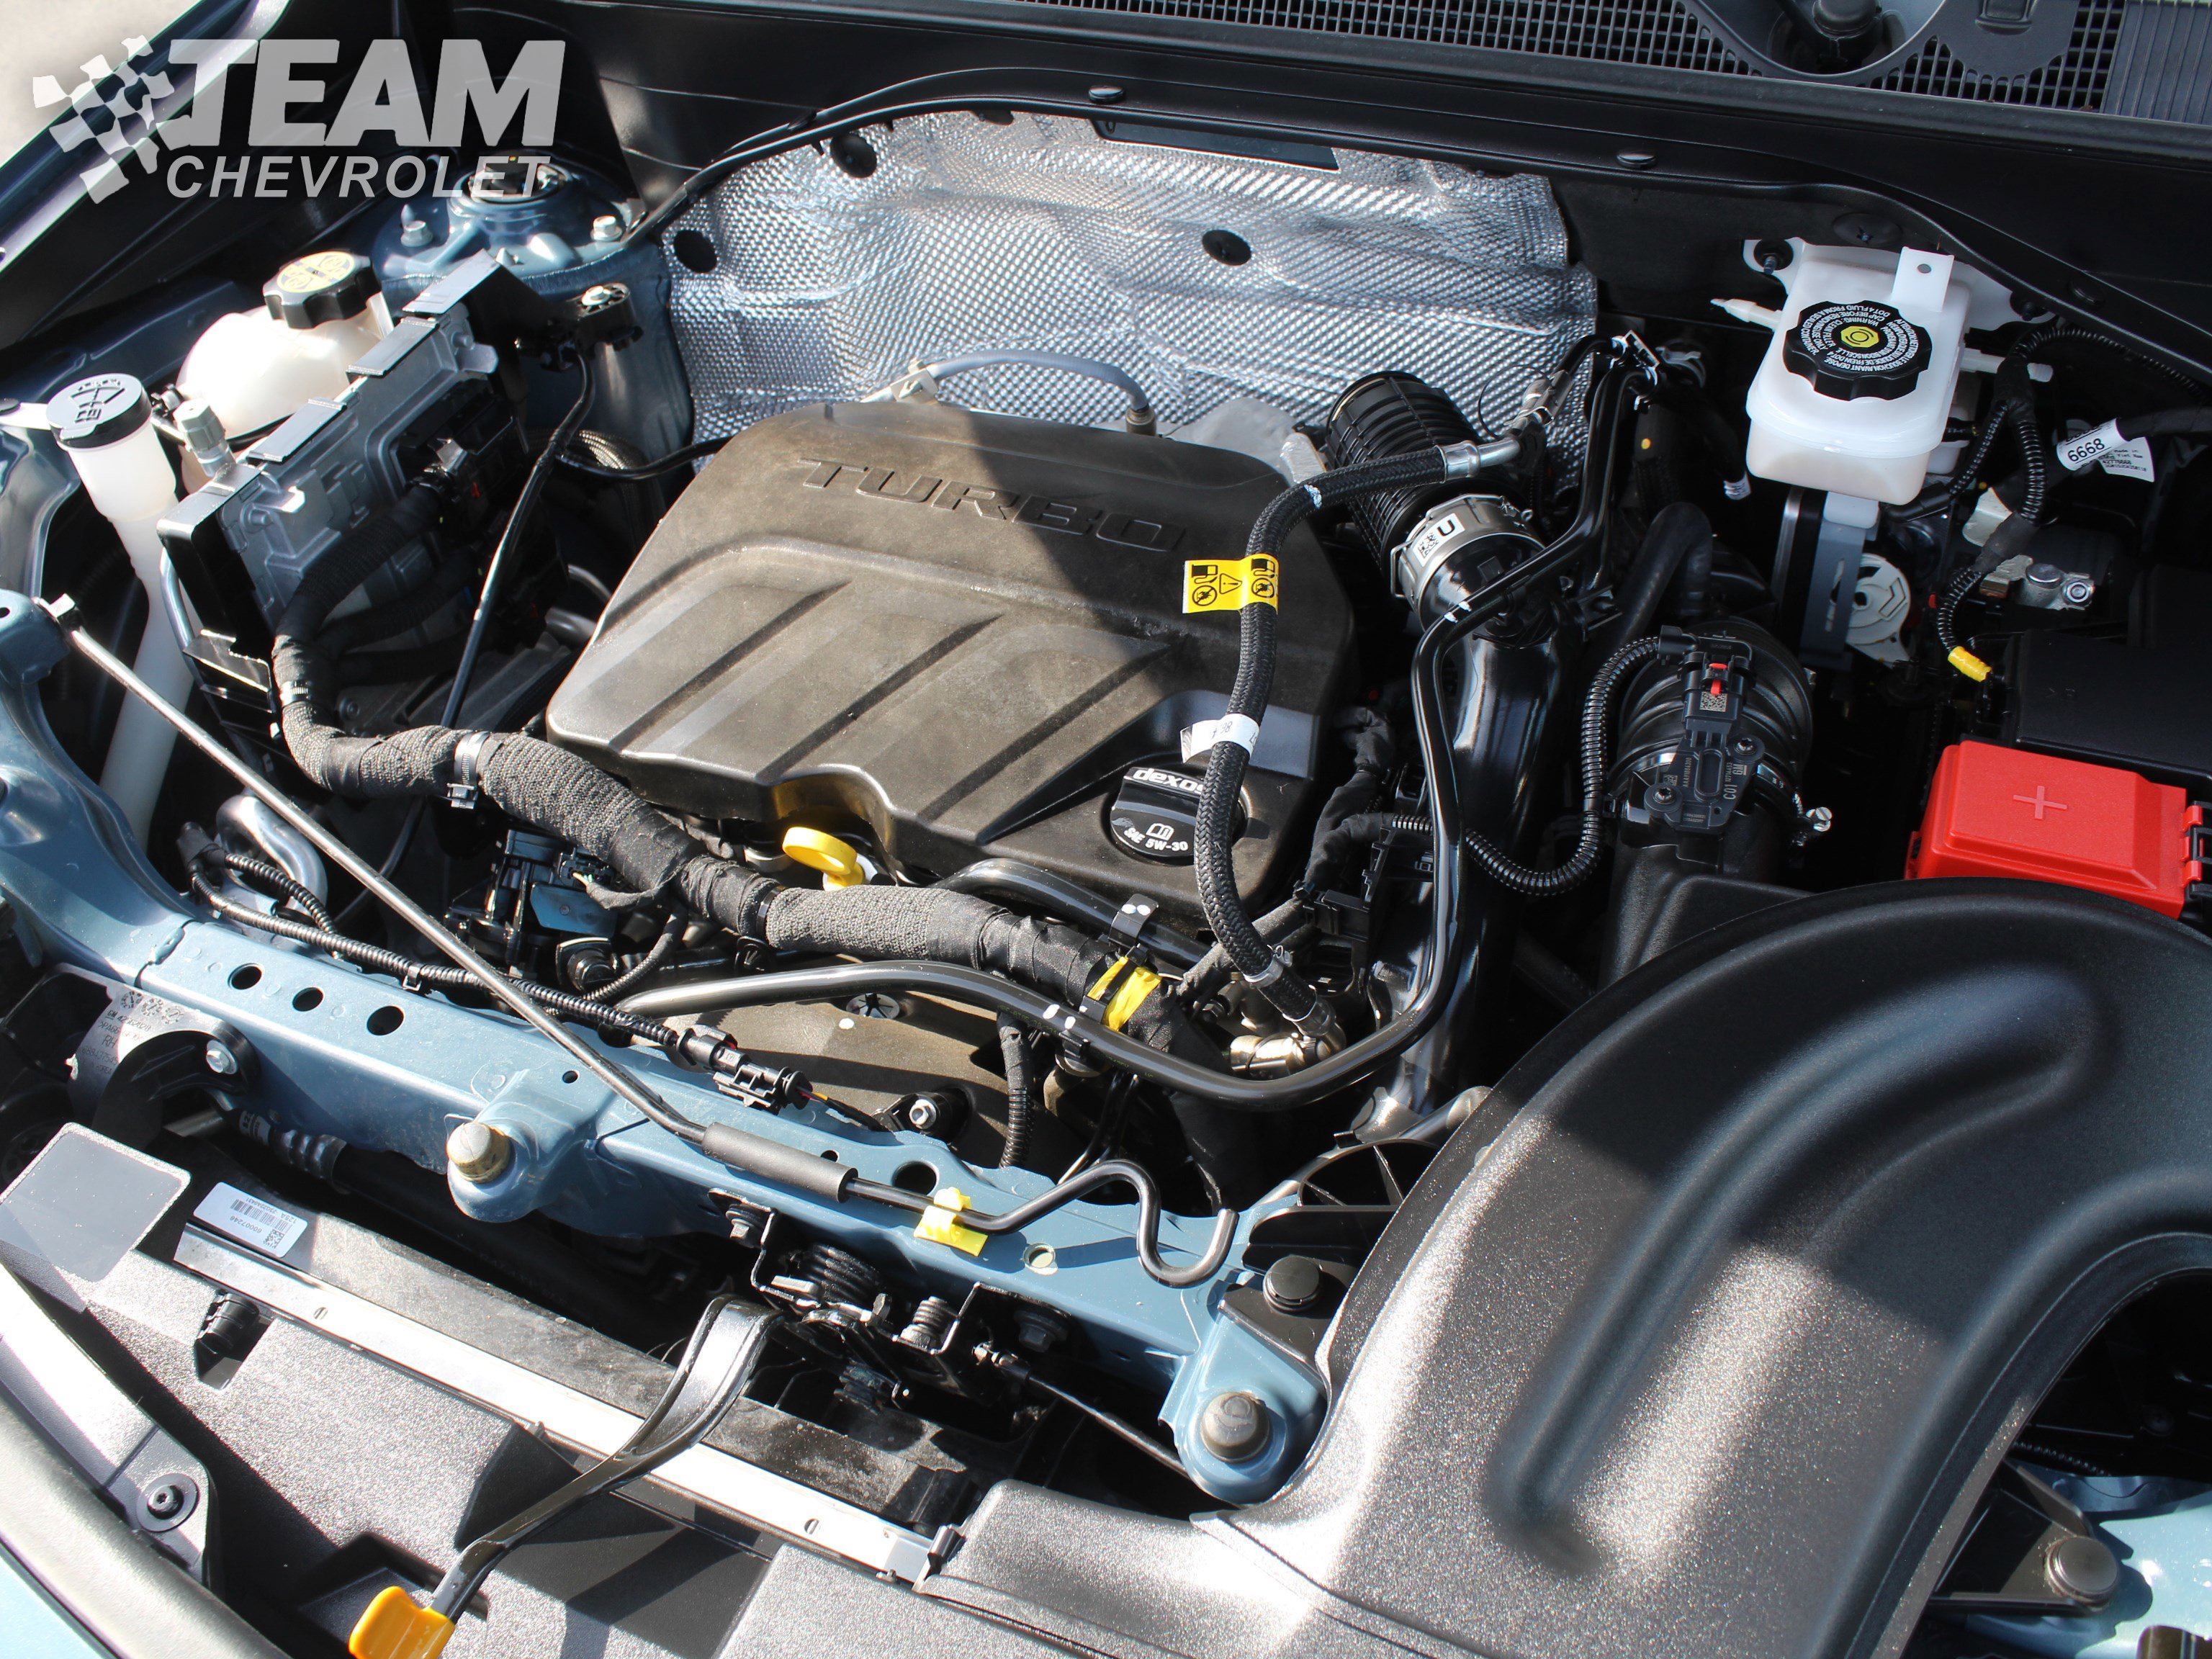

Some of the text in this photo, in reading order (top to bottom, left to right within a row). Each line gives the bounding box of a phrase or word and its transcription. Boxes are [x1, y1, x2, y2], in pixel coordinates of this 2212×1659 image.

[1869, 313, 1885, 322] CAP
[1873, 309, 1891, 318] DOT
[1835, 347, 1863, 359] SCELLE
[2067, 438, 2105, 462] 6668
[797, 458, 1187, 552] TURBO
[1437, 519, 1456, 536] U
[1732, 764, 1745, 775] GM
[1123, 827, 1189, 852] SAE 5W-30
[107, 1010, 118, 1020] GM
[102, 1033, 120, 1048] RH
